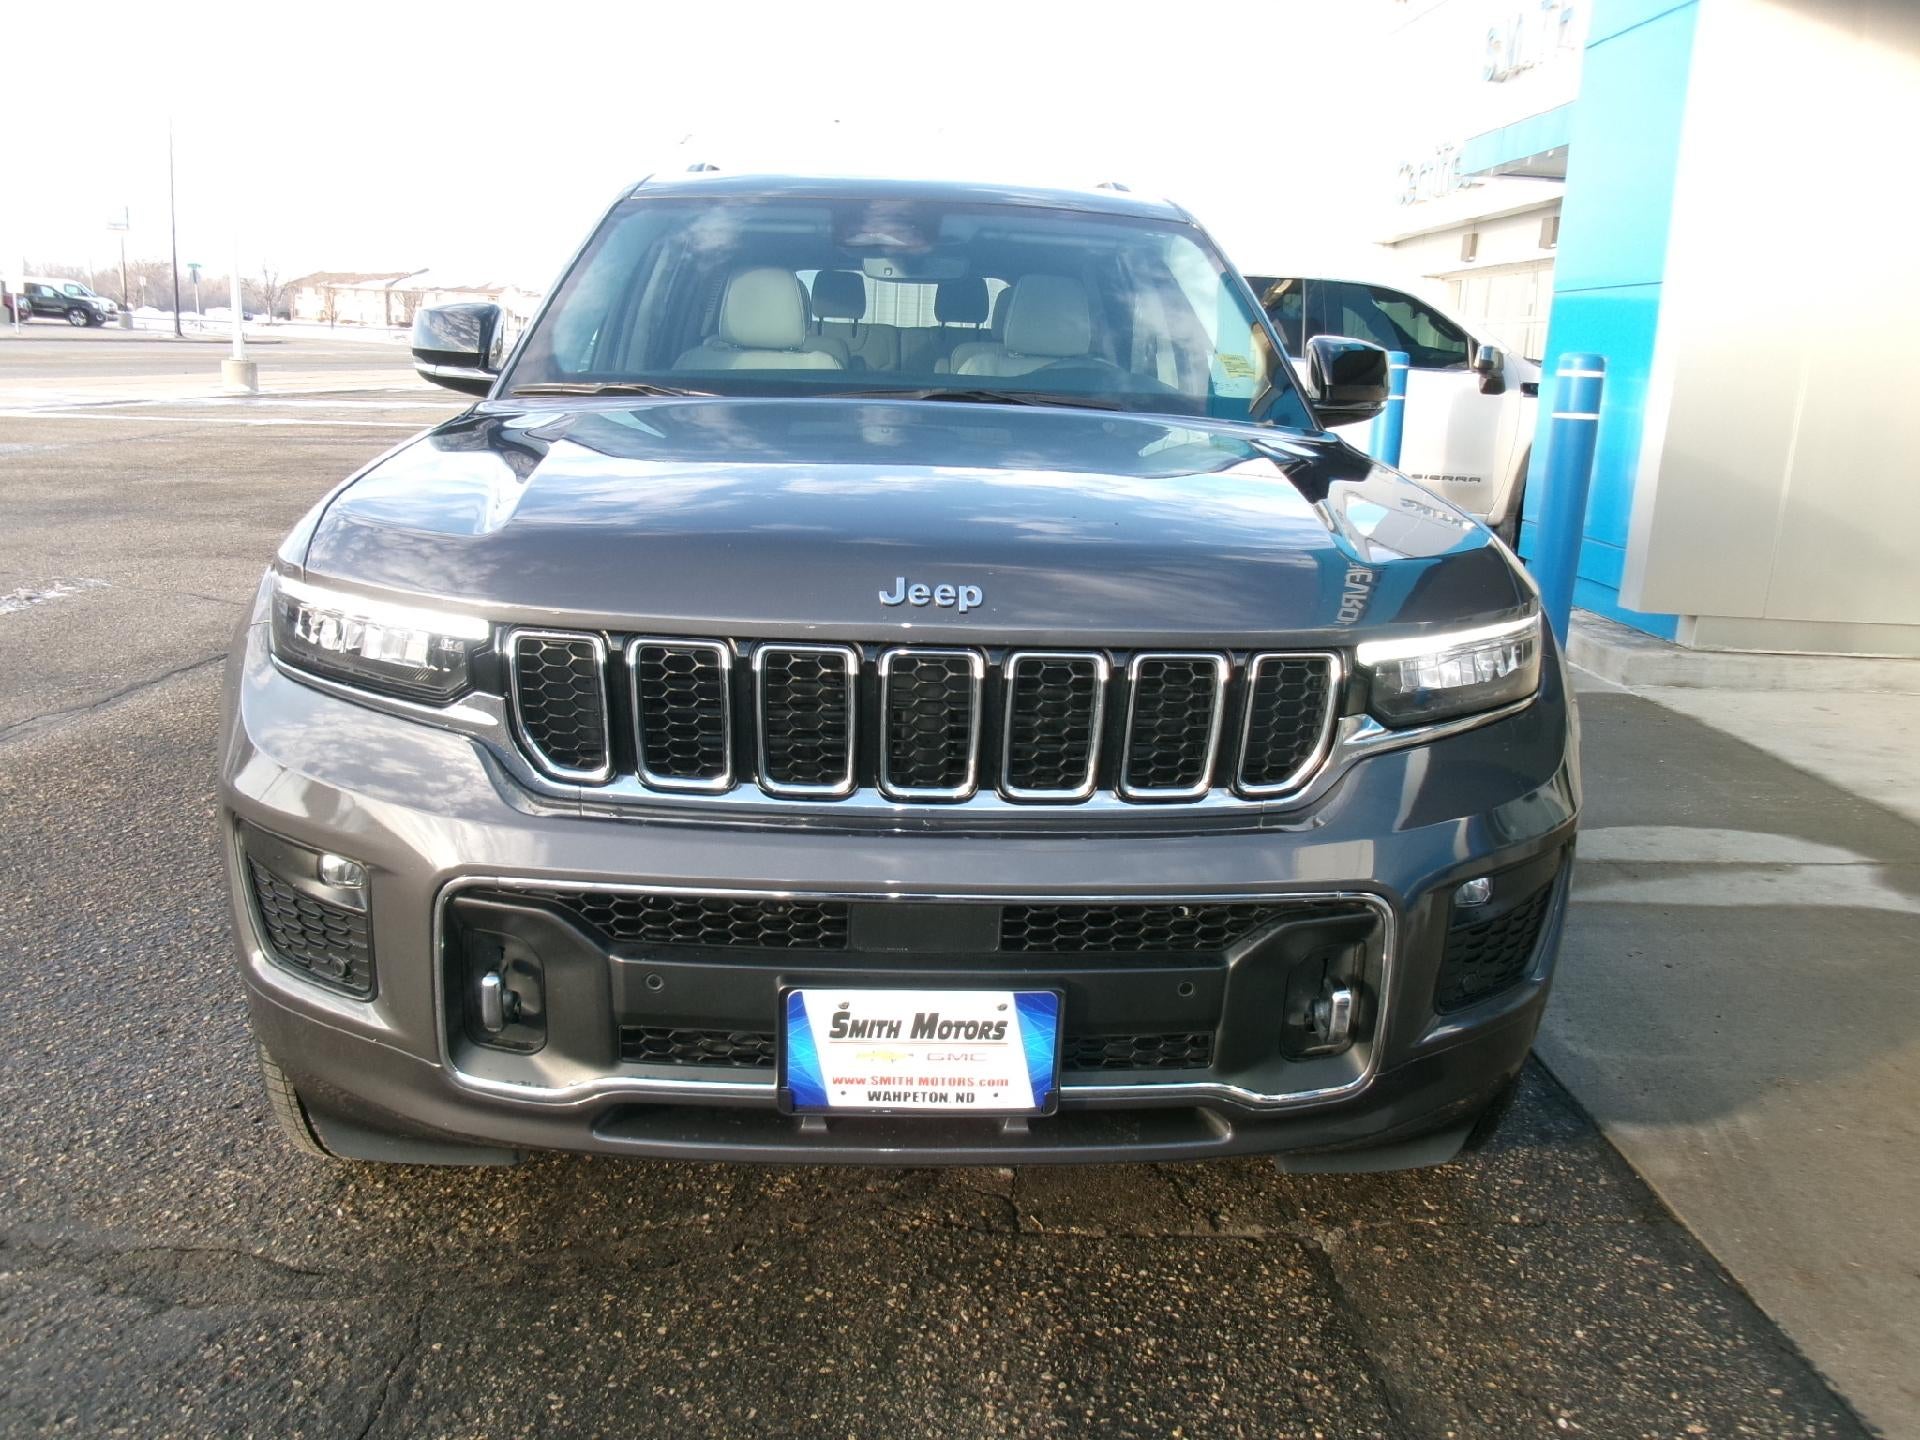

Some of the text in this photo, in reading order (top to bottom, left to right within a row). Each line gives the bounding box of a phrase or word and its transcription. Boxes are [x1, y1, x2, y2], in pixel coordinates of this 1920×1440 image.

[1411, 473, 1481, 483] SIERRA
[879, 576, 983, 614] Jeep
[829, 1011, 1009, 1040] SMITH MOTORS
[927, 1052, 988, 1062] GMC
[955, 1092, 976, 1104] ND
